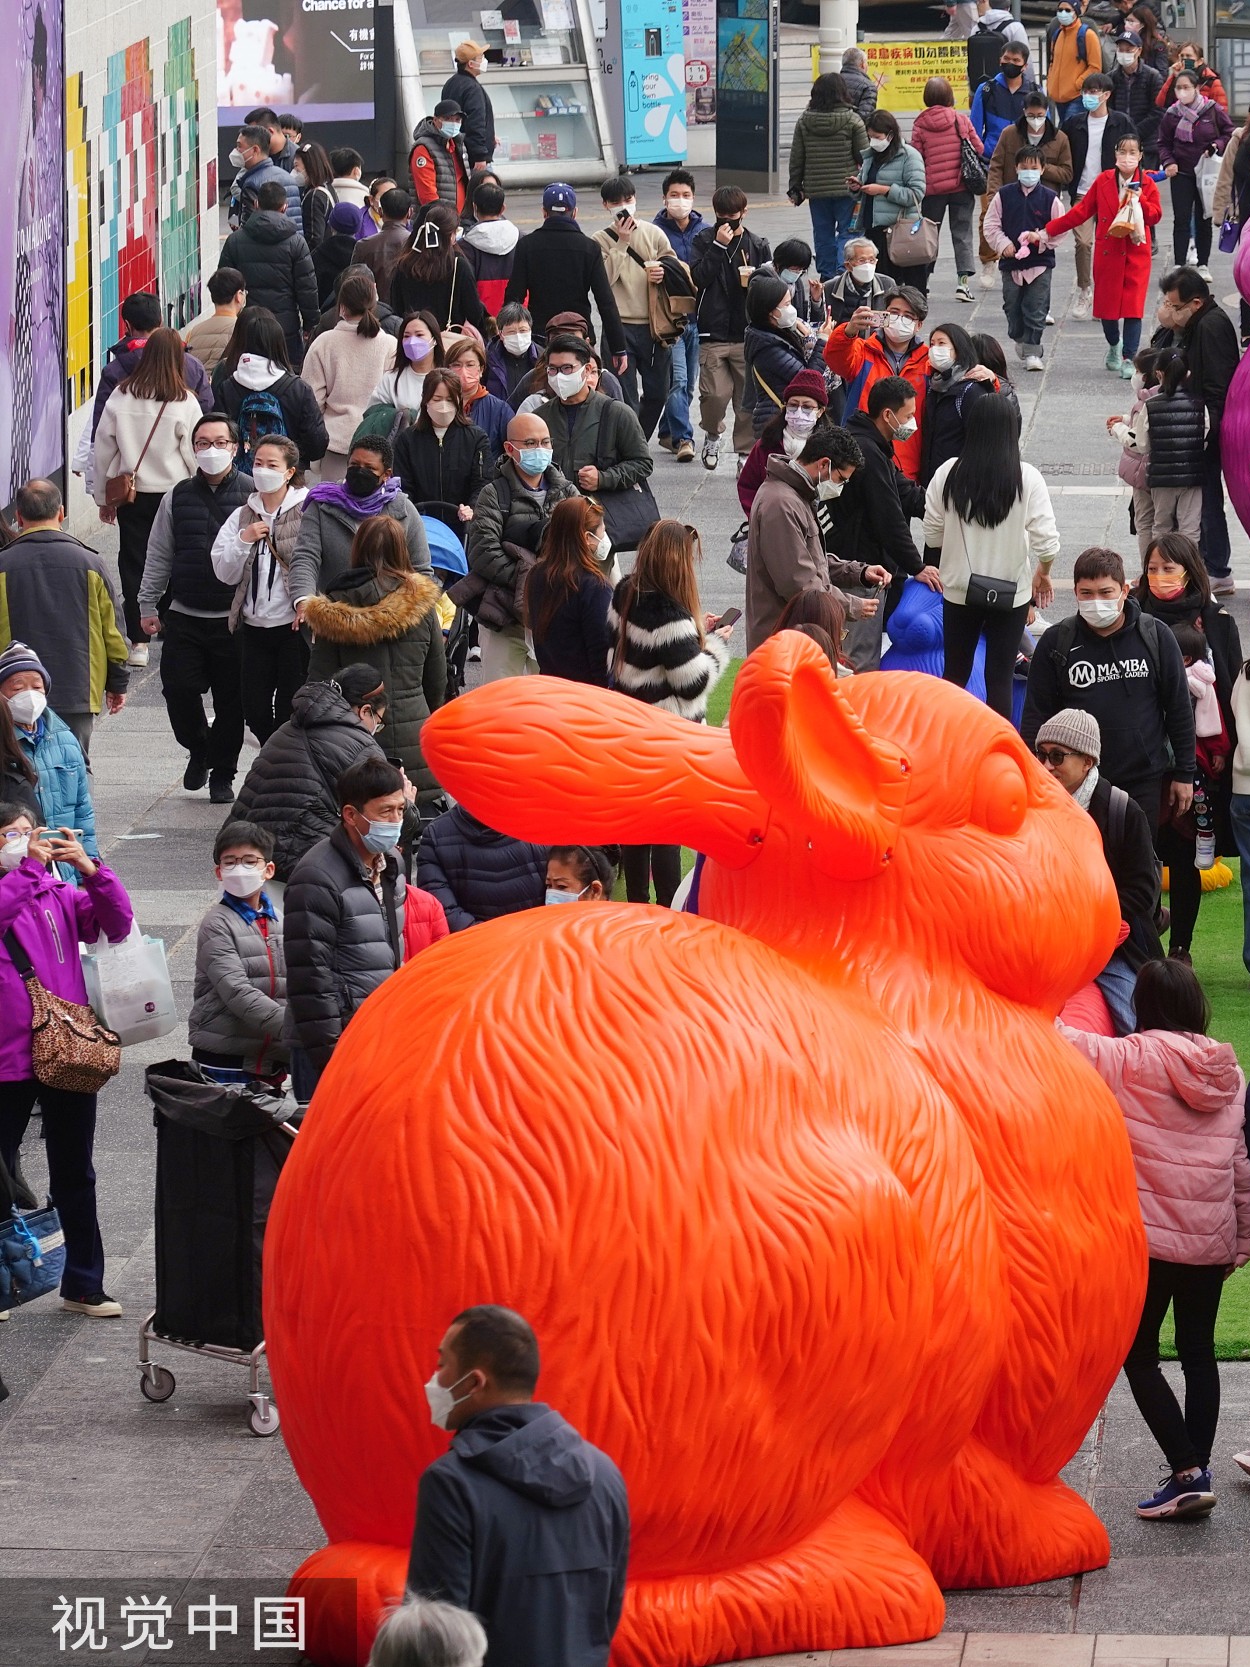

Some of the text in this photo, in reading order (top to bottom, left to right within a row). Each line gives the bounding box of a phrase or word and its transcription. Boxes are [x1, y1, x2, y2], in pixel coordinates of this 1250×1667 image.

[302, 0, 346, 11] Chance
[347, 0, 365, 10] for
[642, 73, 660, 82] bring
[642, 83, 657, 92] your
[642, 101, 662, 109] bottle
[1097, 659, 1149, 676] MAMBA
[1097, 674, 1120, 682] SPORTS
